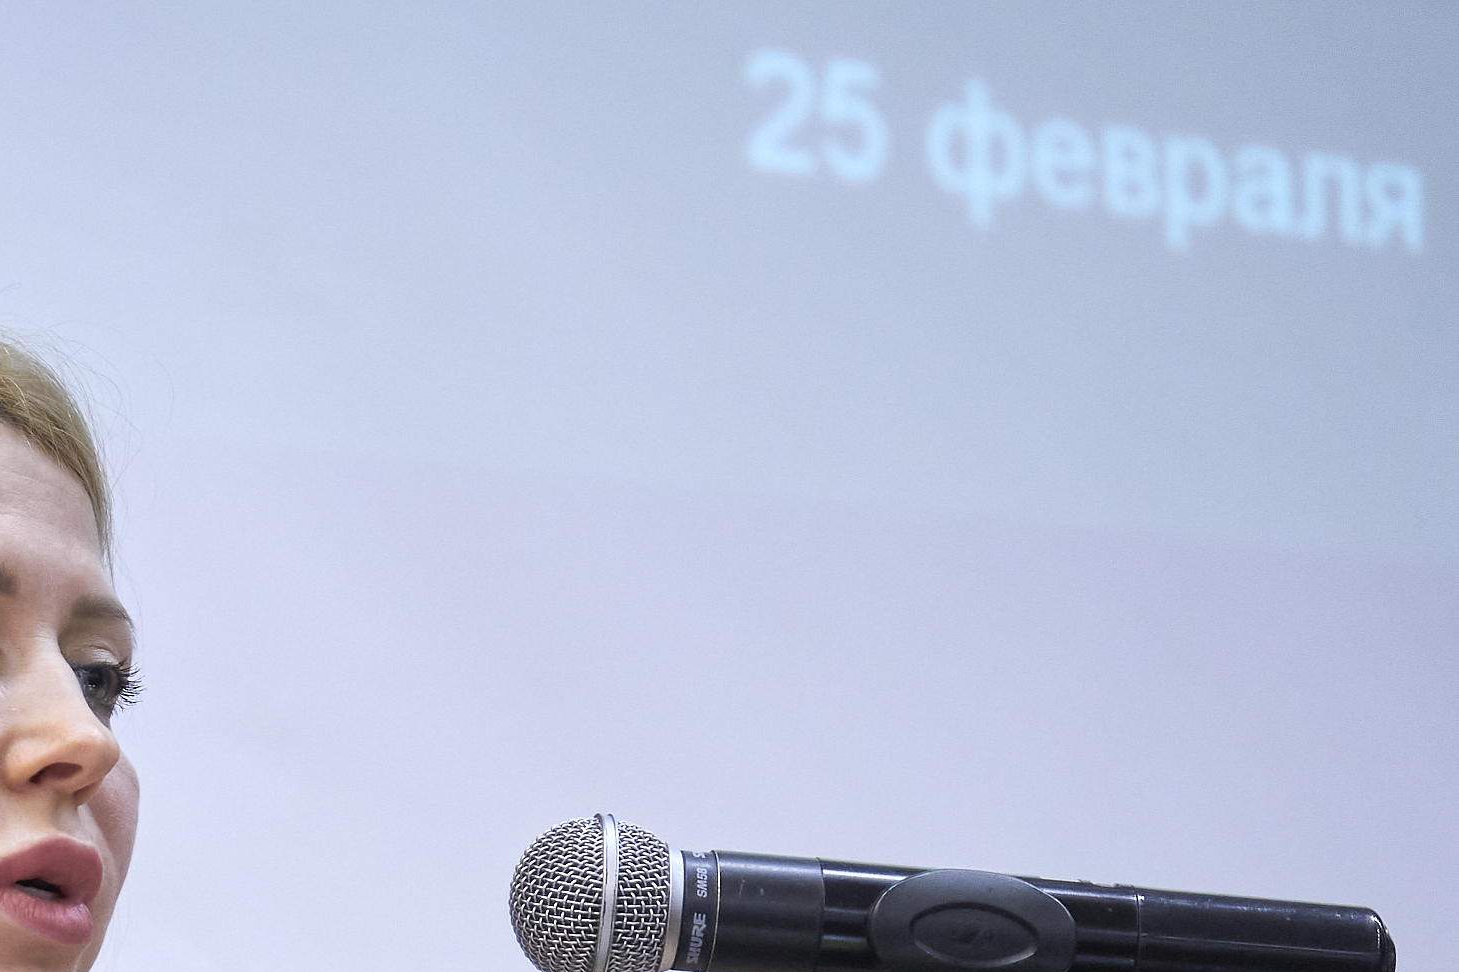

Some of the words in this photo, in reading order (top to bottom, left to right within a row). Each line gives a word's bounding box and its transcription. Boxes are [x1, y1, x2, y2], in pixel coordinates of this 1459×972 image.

[744, 49, 889, 183] 25
[926, 76, 1424, 252] февраля
[696, 867, 708, 898] SM58
[686, 912, 707, 964] SHURE
